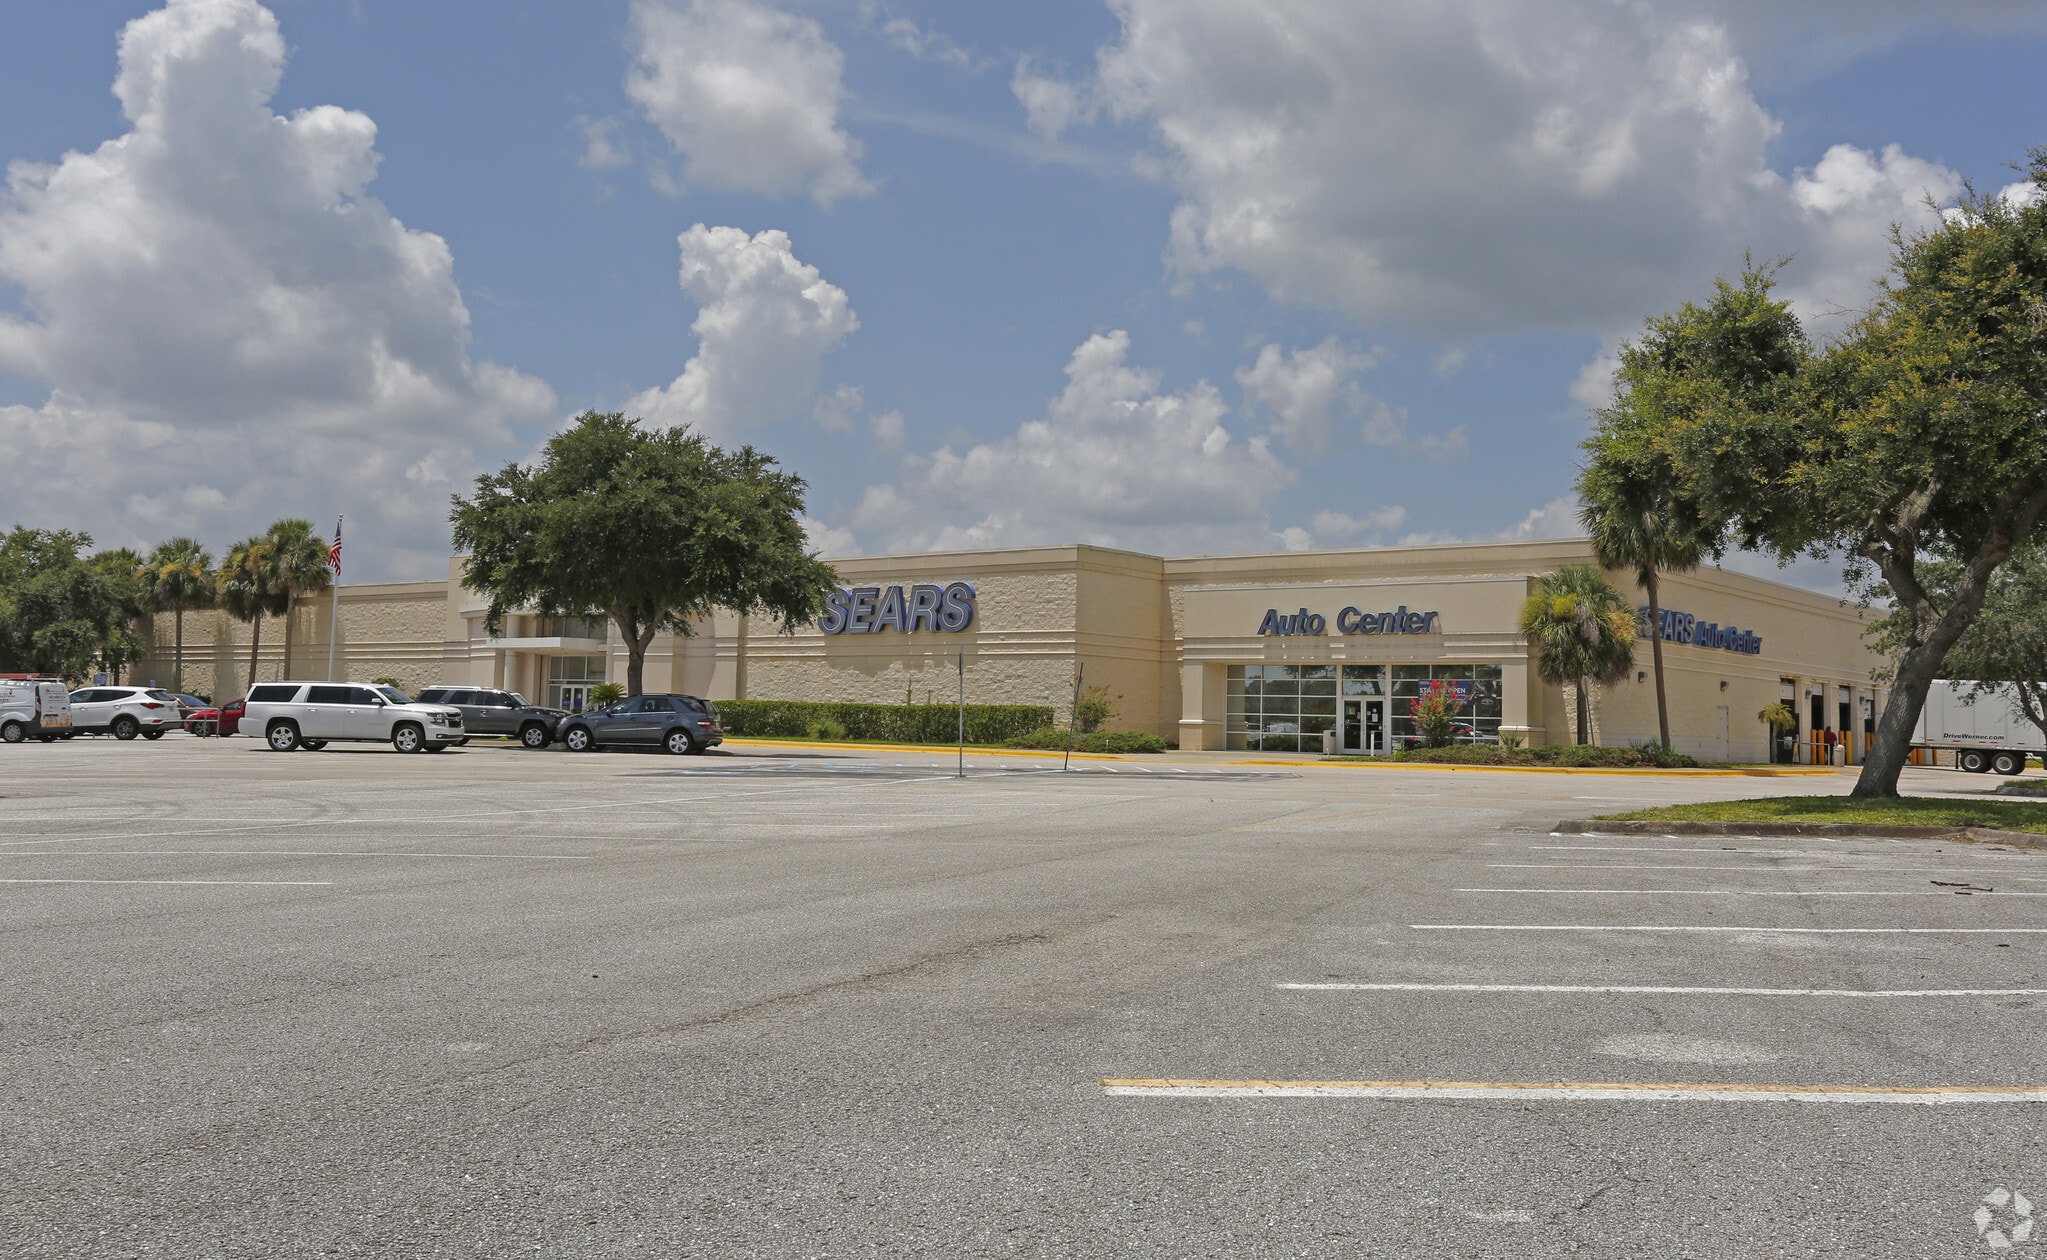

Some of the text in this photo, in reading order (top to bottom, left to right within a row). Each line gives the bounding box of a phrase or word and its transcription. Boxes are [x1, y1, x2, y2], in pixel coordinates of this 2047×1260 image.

[818, 582, 976, 635] SEARS
[1257, 605, 1438, 635] Auto Center
[1695, 620, 1725, 649] Auto
[1725, 626, 1762, 654] Center
[1943, 733, 2004, 741] DriveWerner.com
